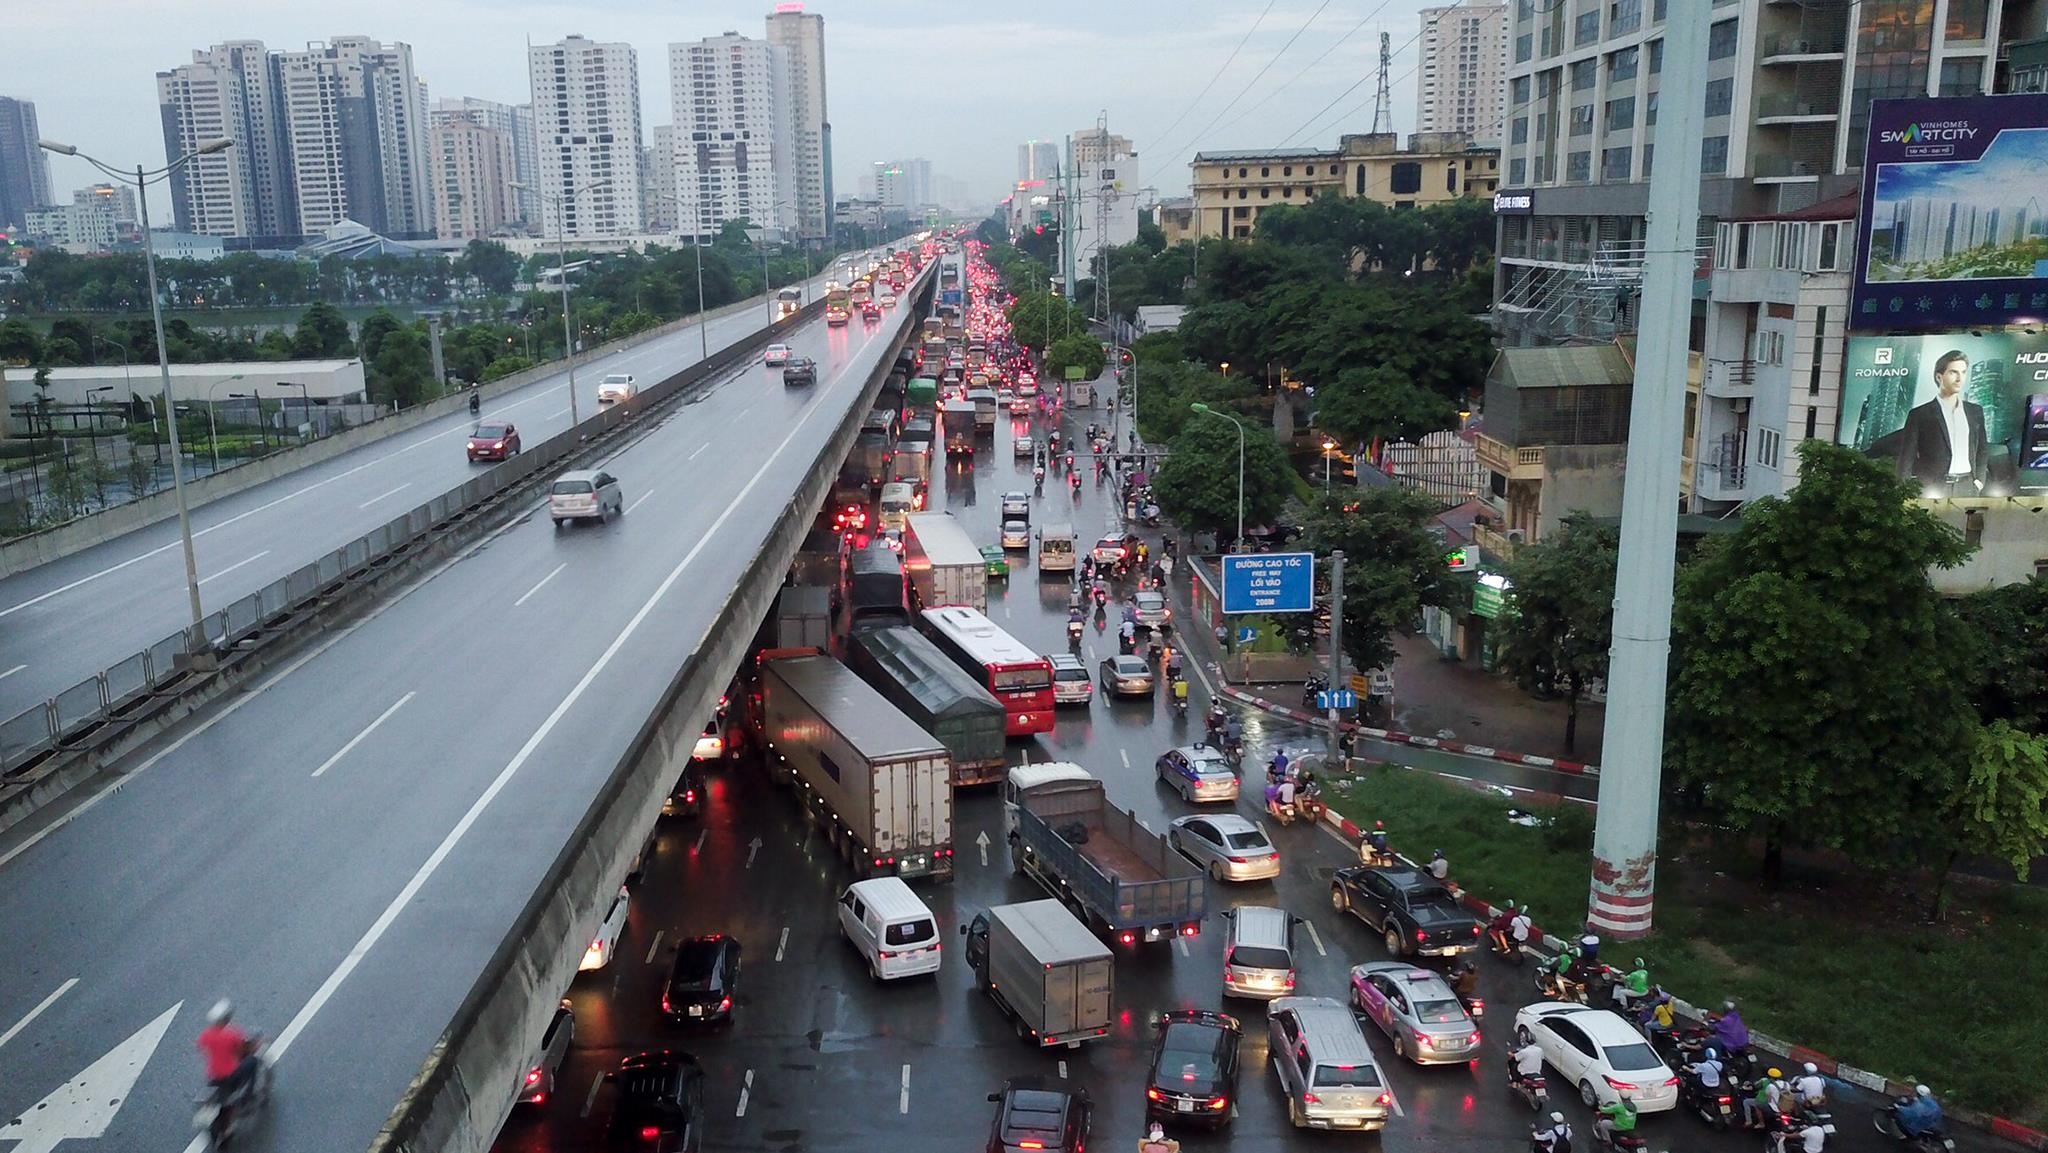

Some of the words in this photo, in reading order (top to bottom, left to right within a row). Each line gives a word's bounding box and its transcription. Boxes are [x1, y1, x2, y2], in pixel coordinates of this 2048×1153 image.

[1920, 121, 1968, 129] VINHOMES
[1855, 367, 1909, 377] ROMANO
[1285, 557, 1301, 567] TỐC
